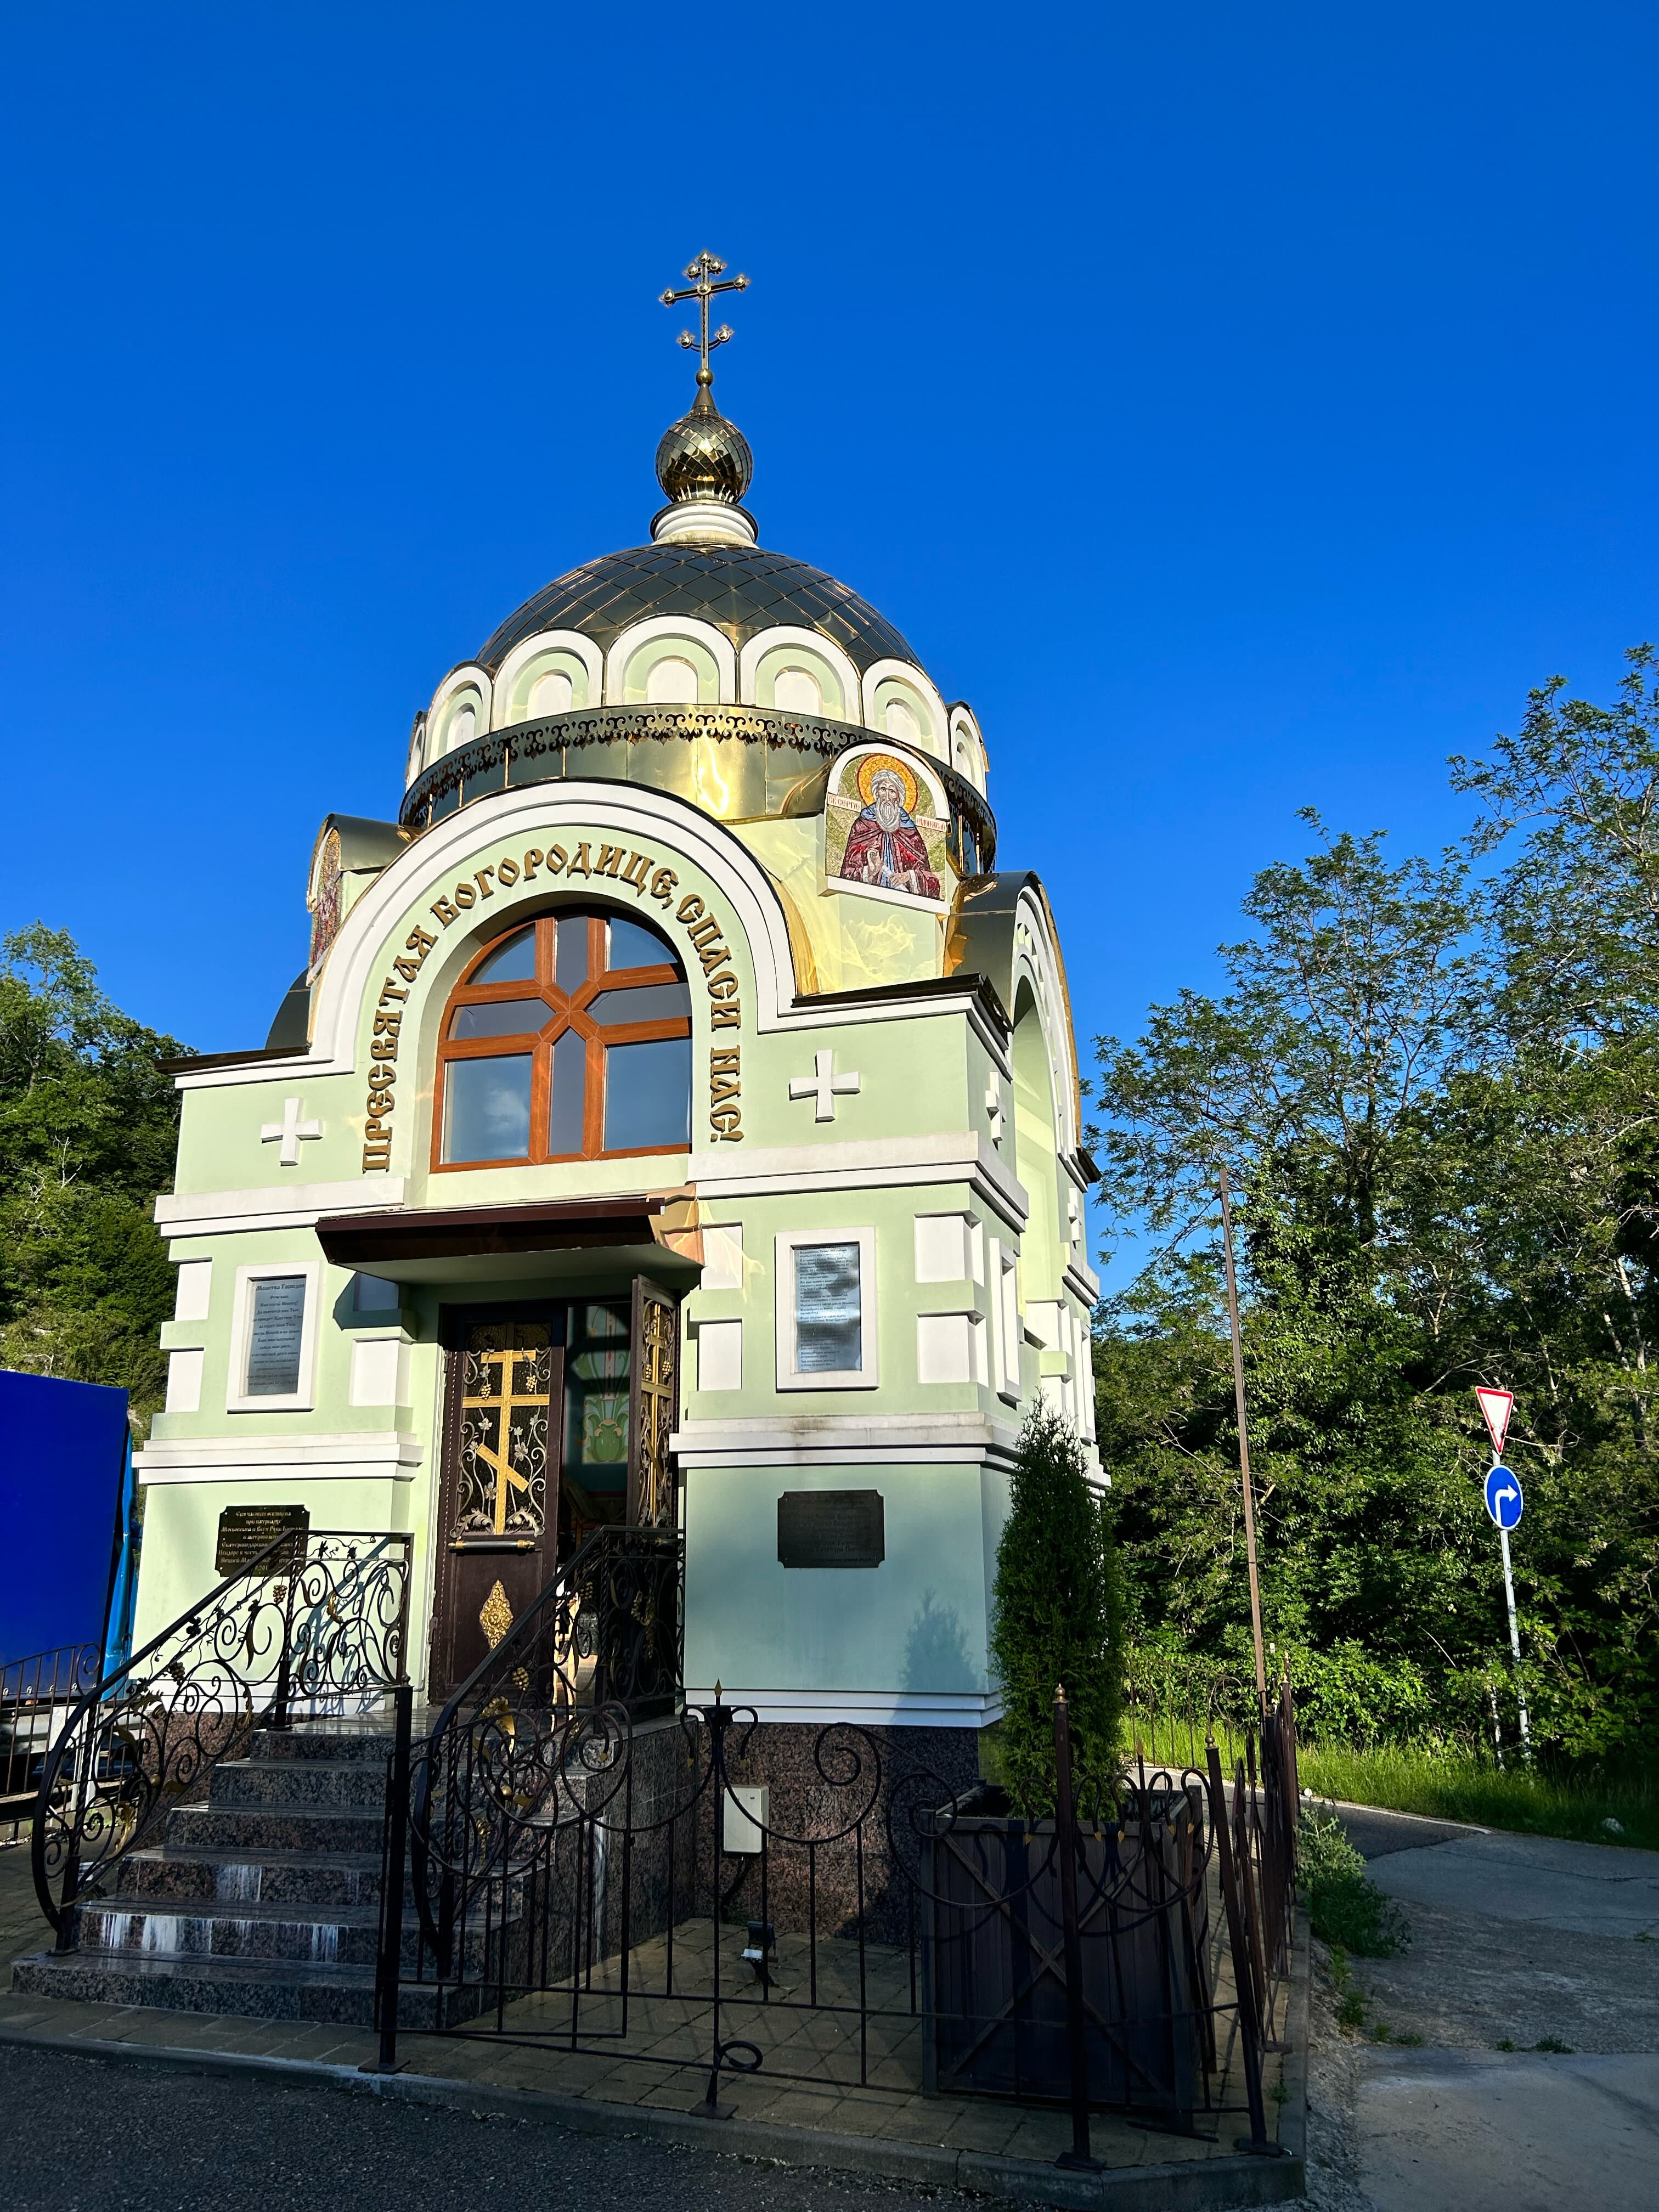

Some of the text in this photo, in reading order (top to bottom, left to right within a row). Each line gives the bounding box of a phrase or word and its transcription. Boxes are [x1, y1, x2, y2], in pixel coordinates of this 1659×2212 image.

[362, 842, 744, 1173] ПРЕСВЯТАЯ БОГОРОДИЦЕ, СПАСИ НАС!
